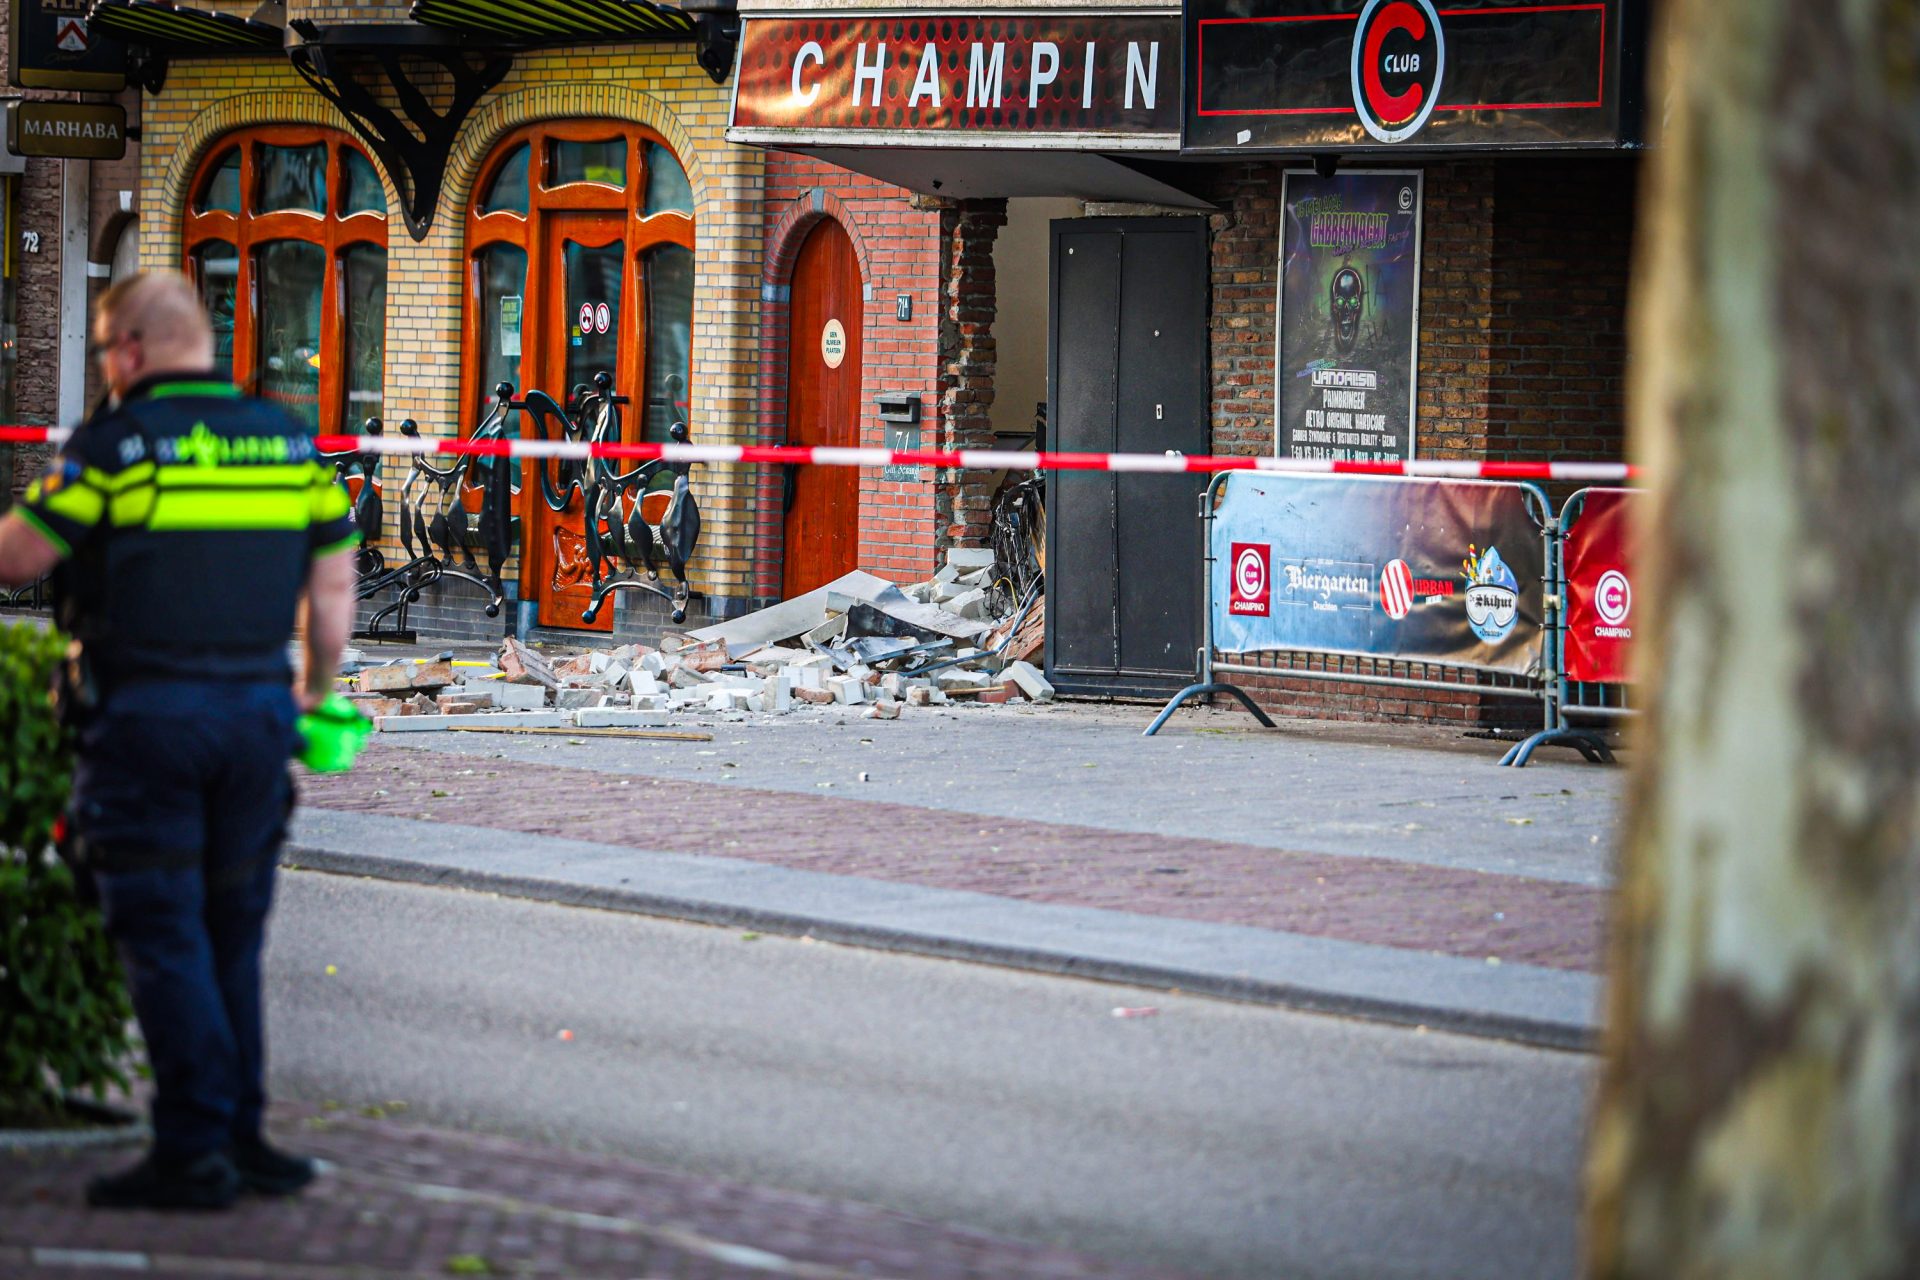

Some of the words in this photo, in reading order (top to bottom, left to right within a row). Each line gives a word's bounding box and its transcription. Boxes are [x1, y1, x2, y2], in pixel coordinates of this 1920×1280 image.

[1384, 53, 1420, 73] CLUB
[791, 41, 1159, 109] CHAMPIN
[24, 119, 120, 140] MARHABA
[22, 231, 39, 253] 72
[1323, 389, 1365, 410] PAINBRINGER
[1306, 410, 1325, 428] RETRO
[1327, 412, 1352, 430] ORIGINAL
[1356, 414, 1385, 431] HARDCORE
[895, 431, 910, 455] 71
[1361, 433, 1378, 446] REALITY
[1284, 565, 1368, 600] Biergarten
[1414, 579, 1454, 597] URBAN
[1234, 601, 1265, 612] CHAMPINO
[1475, 594, 1513, 609] Skihut
[1595, 626, 1631, 638] CHAMPINO
